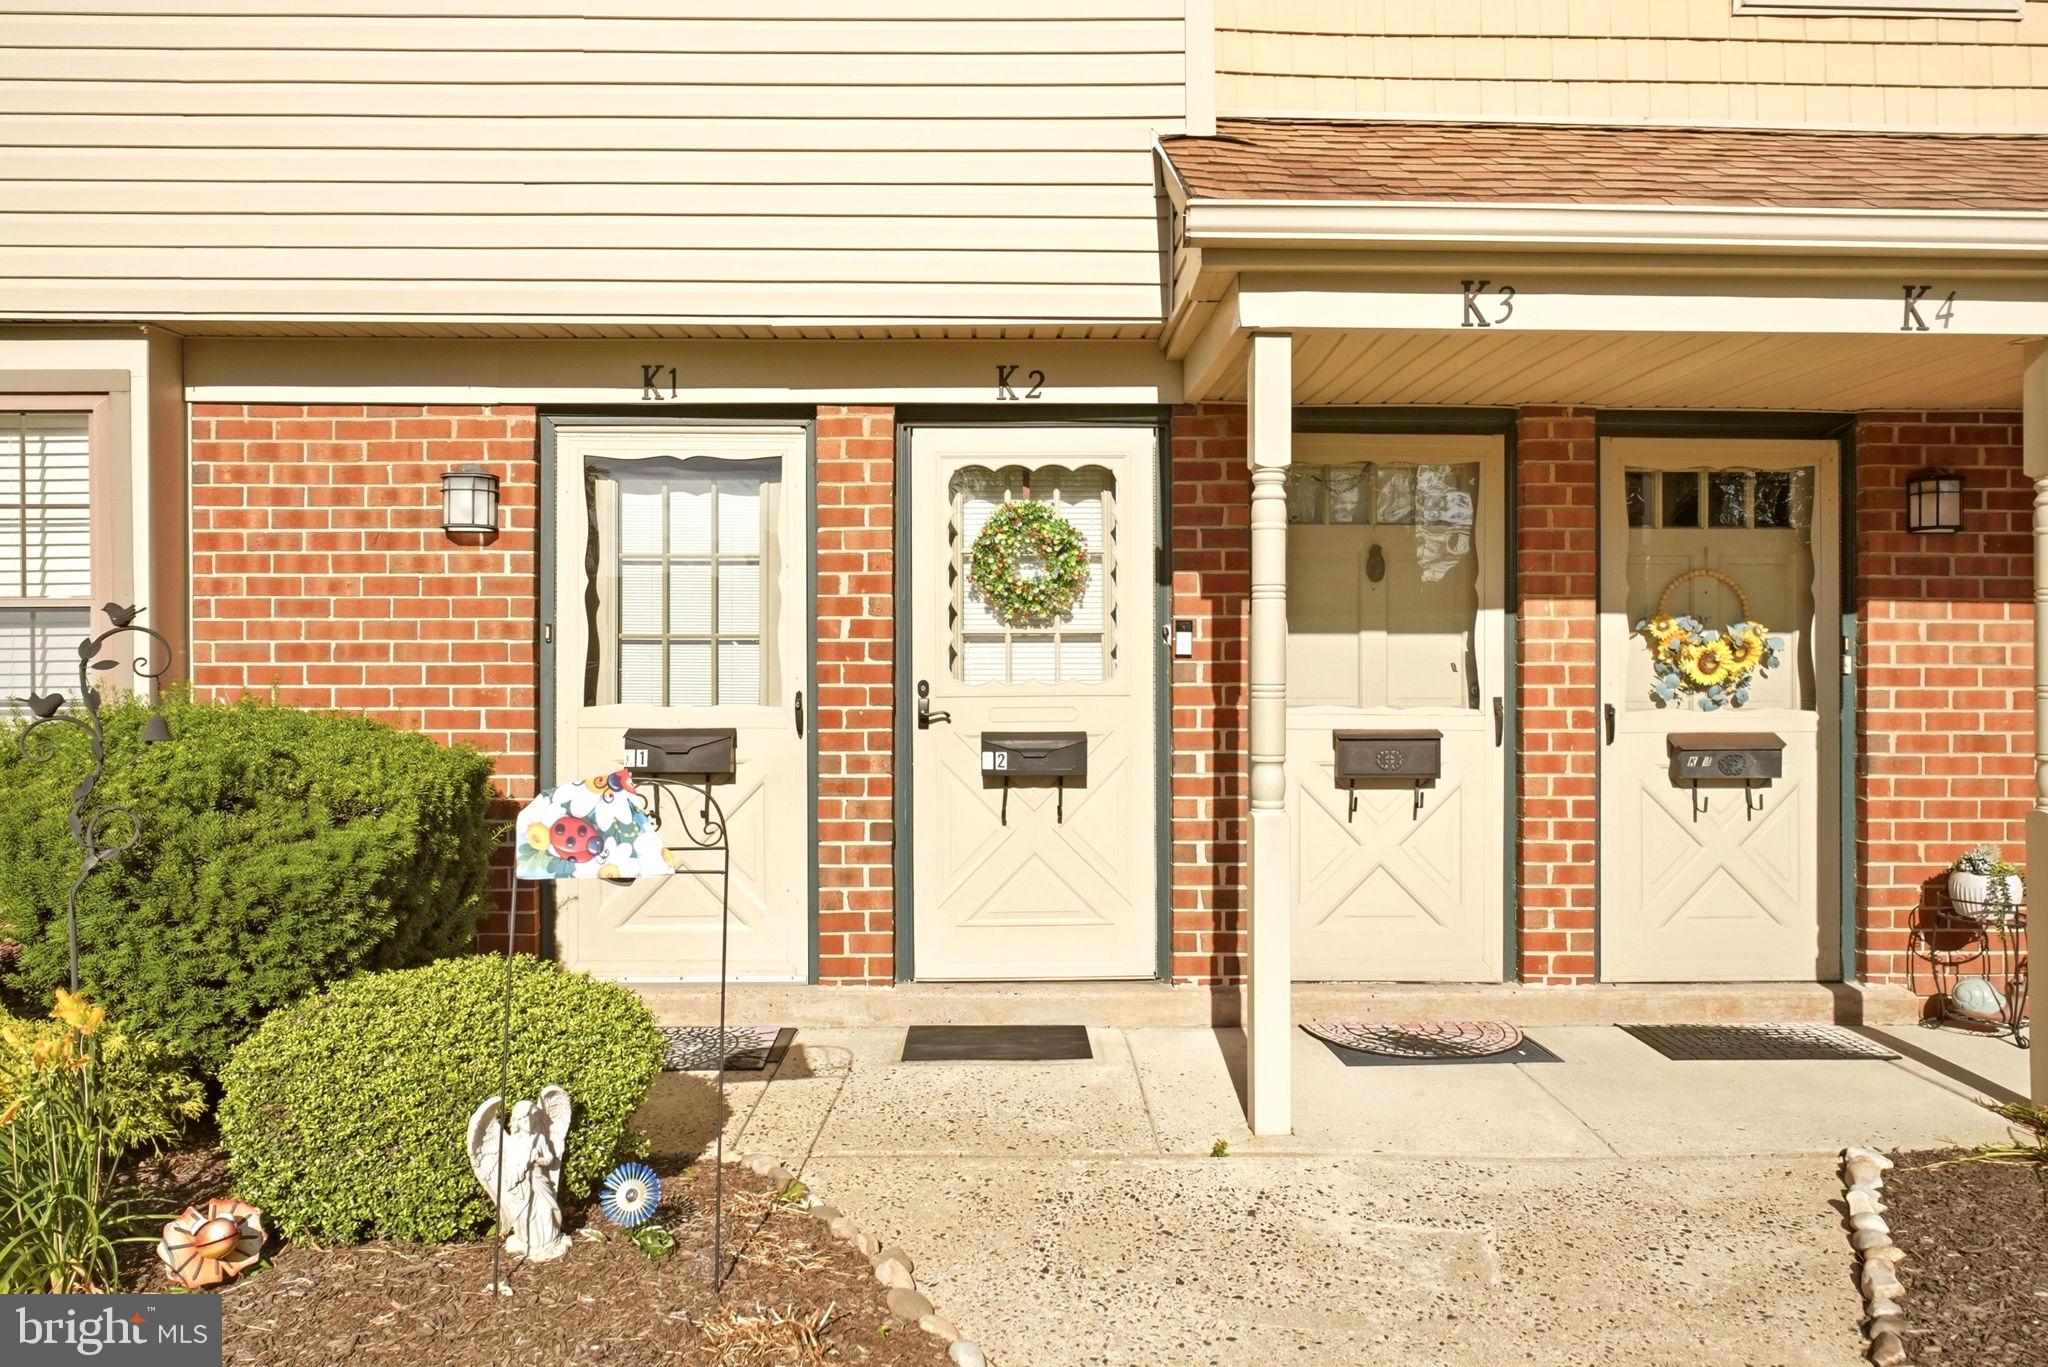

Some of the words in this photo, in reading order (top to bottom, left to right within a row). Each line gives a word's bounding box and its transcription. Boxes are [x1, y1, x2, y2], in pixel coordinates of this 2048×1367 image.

[1461, 280, 1516, 327] K3
[1900, 285, 1957, 331] K4
[641, 364, 678, 401] K1
[996, 365, 1046, 401] K2
